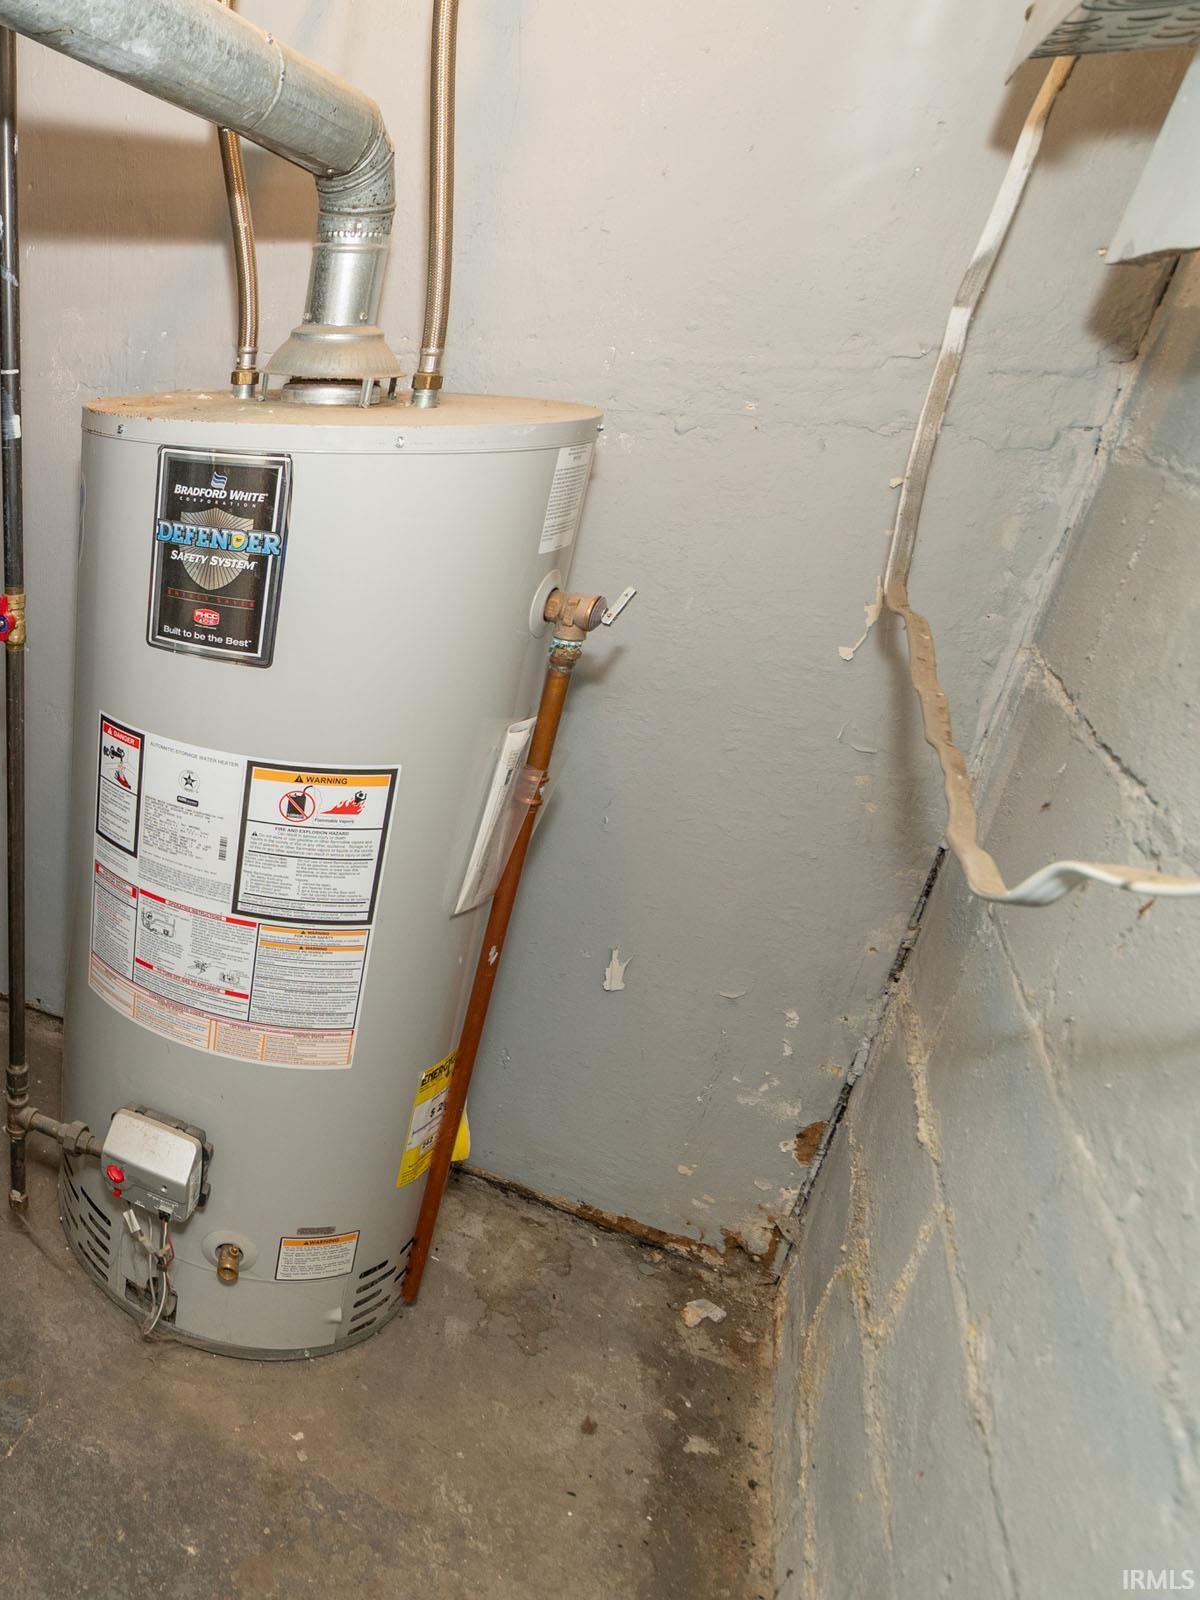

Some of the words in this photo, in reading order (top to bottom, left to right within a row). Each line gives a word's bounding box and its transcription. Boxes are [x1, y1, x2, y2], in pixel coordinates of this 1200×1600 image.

[174, 484, 227, 499] BRADFORD
[229, 490, 265, 502] WHITE
[180, 497, 256, 508] CORPORATION
[157, 519, 282, 556] DEFENDER
[170, 550, 208, 564] SAFETY
[210, 556, 256, 570] SYSTEM
[163, 625, 181, 636] Built
[183, 630, 192, 638] to
[194, 632, 206, 641] be
[208, 634, 223, 644] the
[226, 637, 249, 647] Best
[113, 730, 135, 746] DANGER
[306, 776, 348, 785] WARNING
[309, 1238, 340, 1246] WARNING
